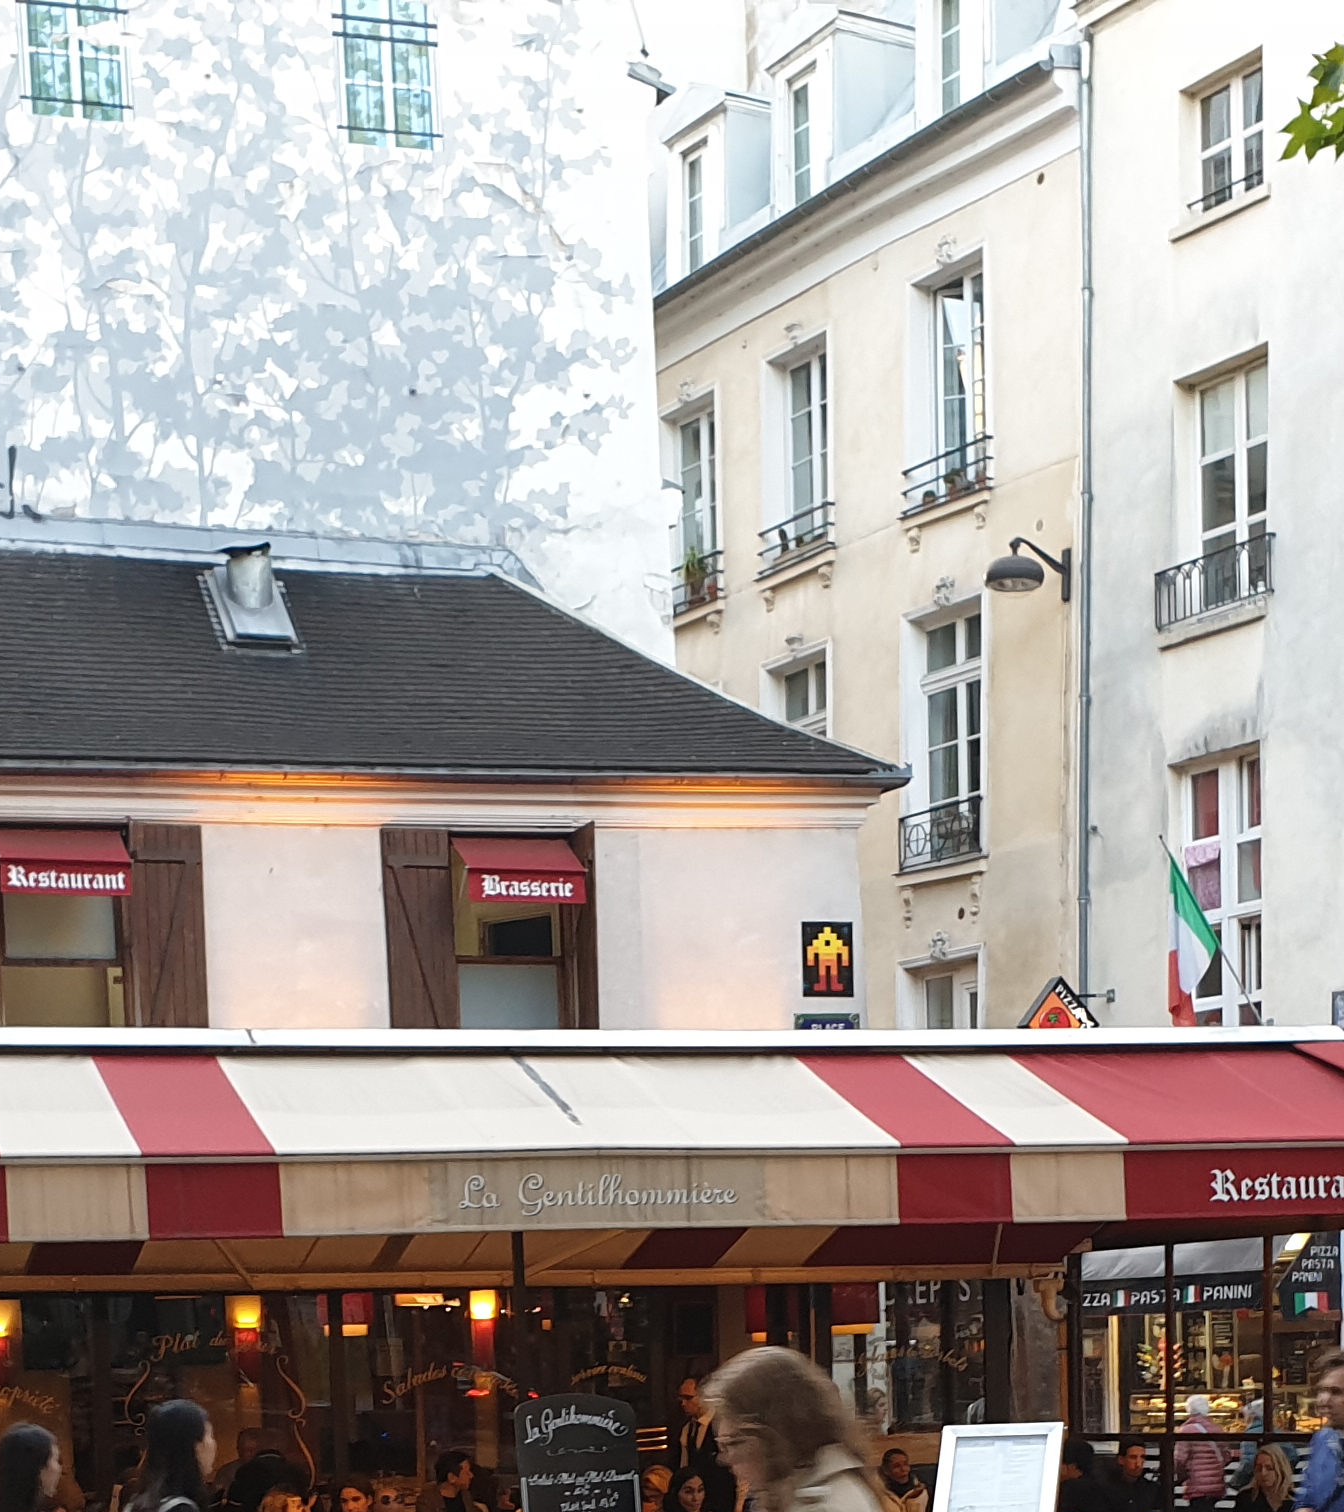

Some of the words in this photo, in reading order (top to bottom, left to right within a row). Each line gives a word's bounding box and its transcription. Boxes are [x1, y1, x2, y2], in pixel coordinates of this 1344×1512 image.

[7, 864, 126, 890] Restaurant
[481, 874, 574, 898] Brasserie
[458, 1174, 501, 1210] La
[518, 1173, 740, 1217] Gentilhommière
[1310, 1245, 1339, 1257] PIZZA
[1302, 1258, 1334, 1270] PASTA
[1203, 1284, 1253, 1301] PANINI
